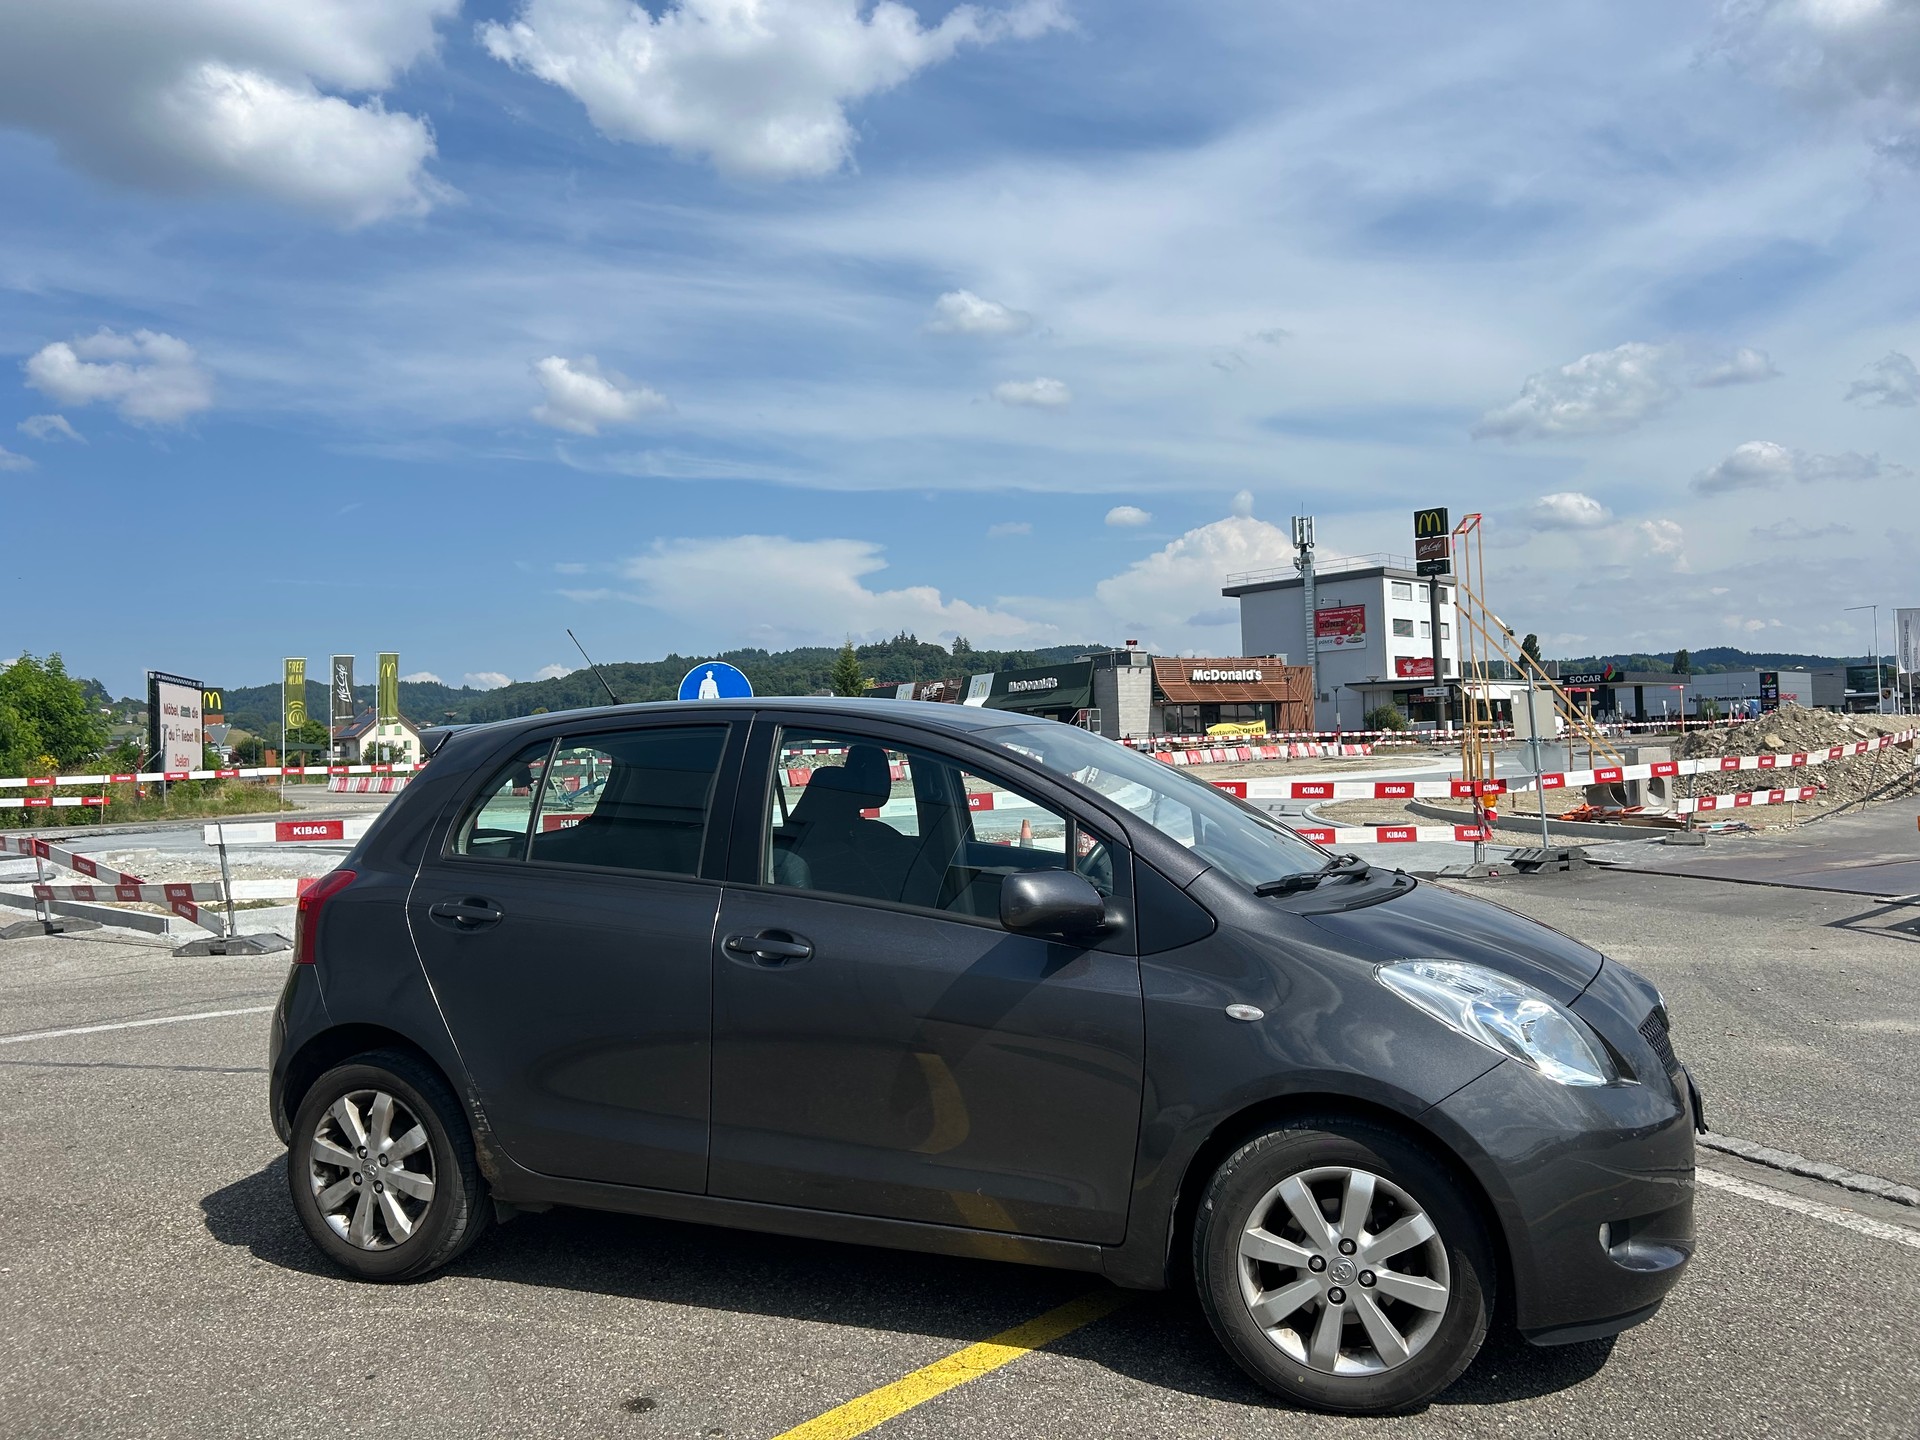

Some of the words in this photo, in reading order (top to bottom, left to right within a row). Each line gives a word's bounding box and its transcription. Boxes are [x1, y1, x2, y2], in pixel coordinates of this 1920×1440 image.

[288, 661, 303, 673] FREE
[1192, 669, 1262, 681] McDonald's
[288, 675, 303, 685] WLAN
[1569, 675, 1601, 684] SOCAR
[1008, 677, 1058, 693] McDonald's
[1657, 765, 1672, 773] KIBAG
[1600, 771, 1617, 779] KIBAG
[1543, 777, 1558, 785] KIBAG
[1302, 786, 1324, 794] KIBAG
[1385, 786, 1406, 794] KIBAG
[293, 825, 327, 835] KIBAG
[1386, 831, 1407, 839] KIBAG
[171, 889, 187, 897] KIBAG
[178, 903, 192, 916] KIBAG
